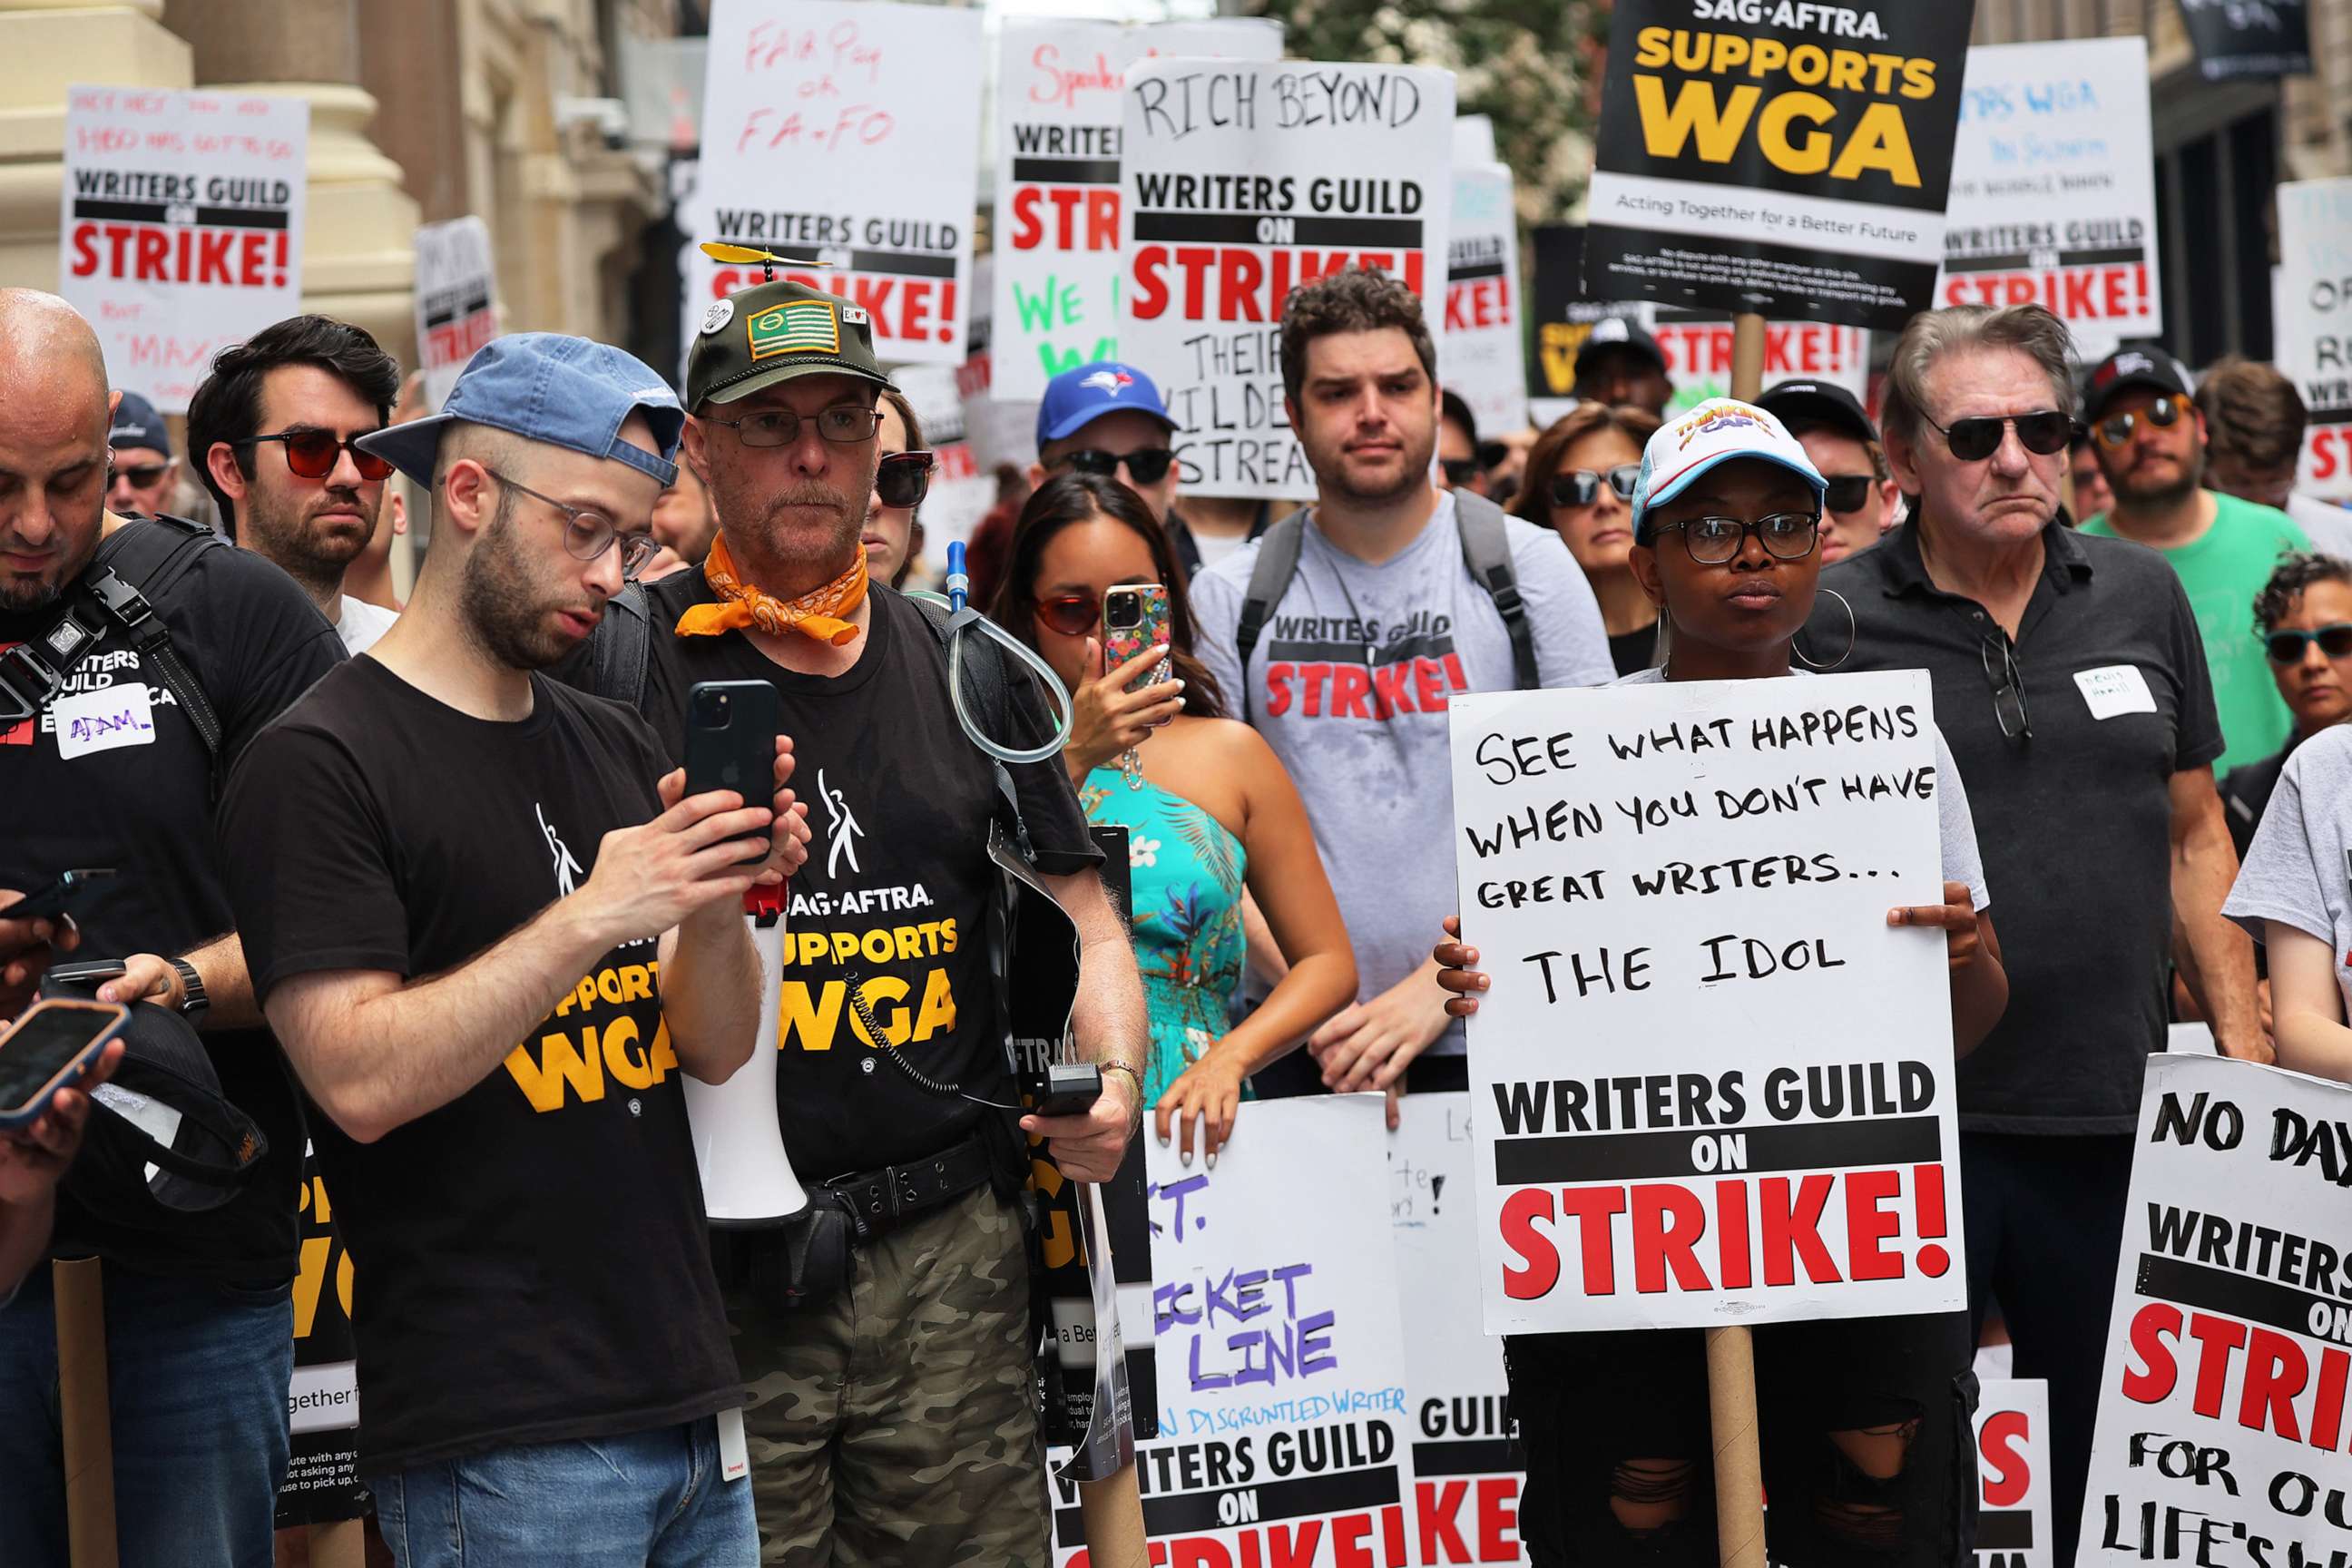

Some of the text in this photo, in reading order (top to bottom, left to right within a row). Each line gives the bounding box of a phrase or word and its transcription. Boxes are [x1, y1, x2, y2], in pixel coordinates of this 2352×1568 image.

[1633, 27, 1936, 100] SUPPORTS
[1133, 71, 1421, 141] RICH BEYOND
[1633, 74, 1922, 188] WGA
[74, 167, 290, 205] WRITERS GUILD
[1136, 172, 1295, 211] WRITERS
[1309, 178, 1424, 215] GUILD
[716, 209, 958, 251] WRITERS GUILD
[1257, 218, 1296, 245] ON
[1449, 234, 1504, 260] UILD
[1615, 193, 1918, 244] Acting Together for a Better Future
[1945, 218, 2144, 250] WRITERS GUILD
[71, 220, 289, 289] STRIKE!
[1012, 271, 1086, 333] WE
[1945, 262, 2149, 319] STRIKE!
[1656, 323, 1841, 373] STRKE!
[1475, 704, 1919, 786] SEE WHAT HAPPENS
[1465, 766, 1936, 859] WHEN YOU DON'T HAVE
[1477, 853, 1900, 909] GREAT WRITERS...
[784, 917, 958, 966] UPPORTS
[1523, 935, 1847, 1004] THE IDOL
[778, 967, 958, 1052] WGA
[503, 1010, 680, 1113] WGA
[1492, 1069, 1748, 1136] WRITERS
[1764, 1061, 1936, 1123] GUILD
[2150, 1092, 2244, 1152] NO
[1690, 1133, 1748, 1172] ON
[1499, 1163, 1951, 1300] STRIKE!
[1189, 1310, 1338, 1392] LINE
[2122, 1303, 2352, 1454] STRI
[1187, 1396, 1329, 1436] DISGRUNTLED
[1331, 1387, 1407, 1416] WRITER
[300, 1465, 336, 1476] asking
[338, 1463, 355, 1474] any
[309, 1452, 333, 1464] with
[335, 1451, 353, 1462] any
[1268, 1418, 1395, 1477] GUILD
[2129, 1432, 2242, 1497] FOR
[299, 1480, 311, 1490] to
[313, 1476, 337, 1490] pick
[1218, 1489, 1259, 1526] ON
